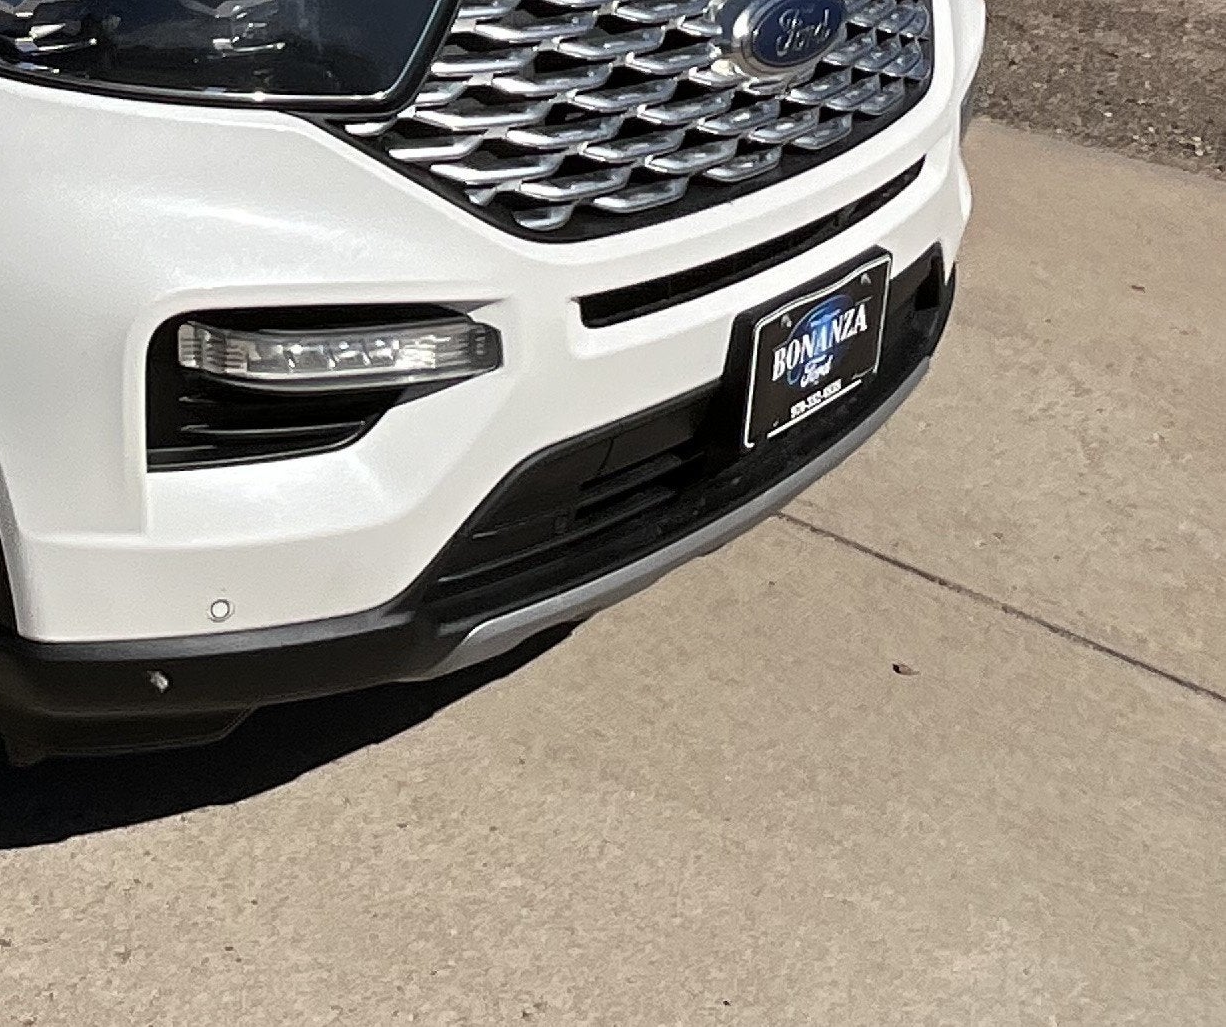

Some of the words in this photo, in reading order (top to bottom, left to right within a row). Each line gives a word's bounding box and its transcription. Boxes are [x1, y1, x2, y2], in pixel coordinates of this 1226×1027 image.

[776, 8, 830, 57] Ford
[772, 303, 868, 382] BONANZA
[800, 354, 834, 388] Ford
